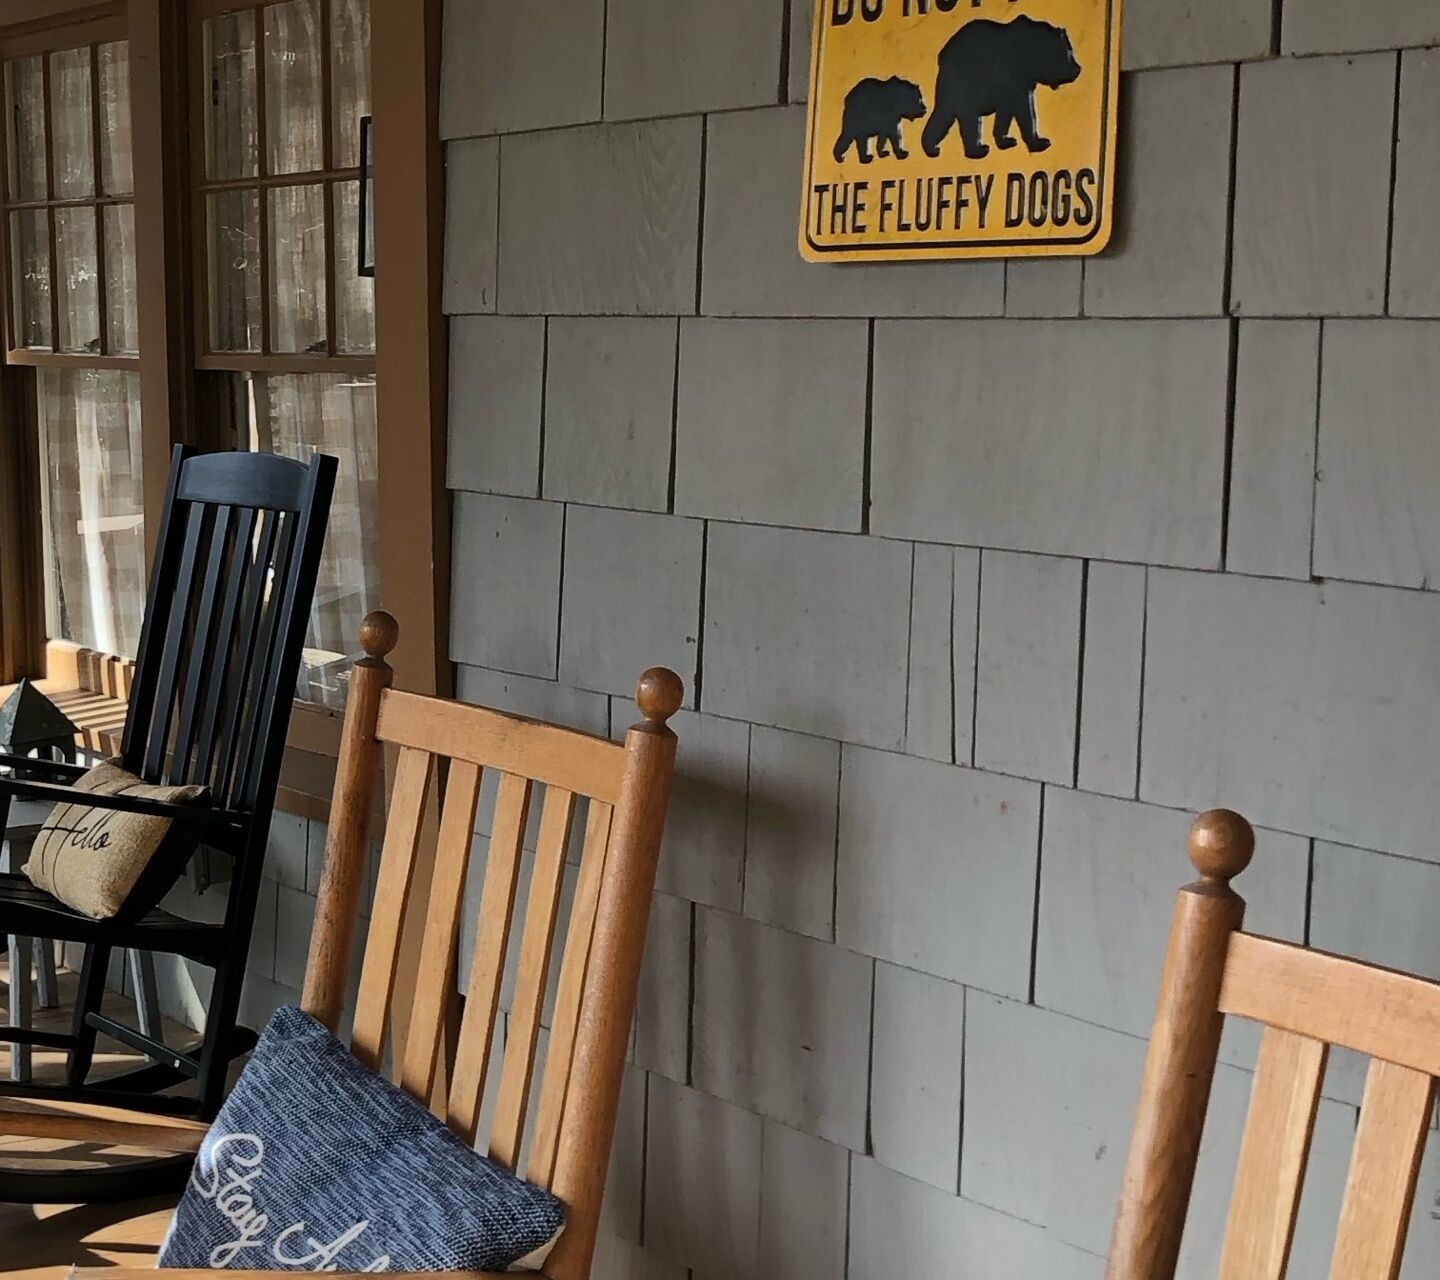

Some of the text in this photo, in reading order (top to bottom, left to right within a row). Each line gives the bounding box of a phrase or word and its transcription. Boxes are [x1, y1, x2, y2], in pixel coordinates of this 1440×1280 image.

[814, 168, 1095, 236] THE FLUFFY DOGS
[40, 788, 130, 898] Hello
[191, 1132, 266, 1269] Stay
